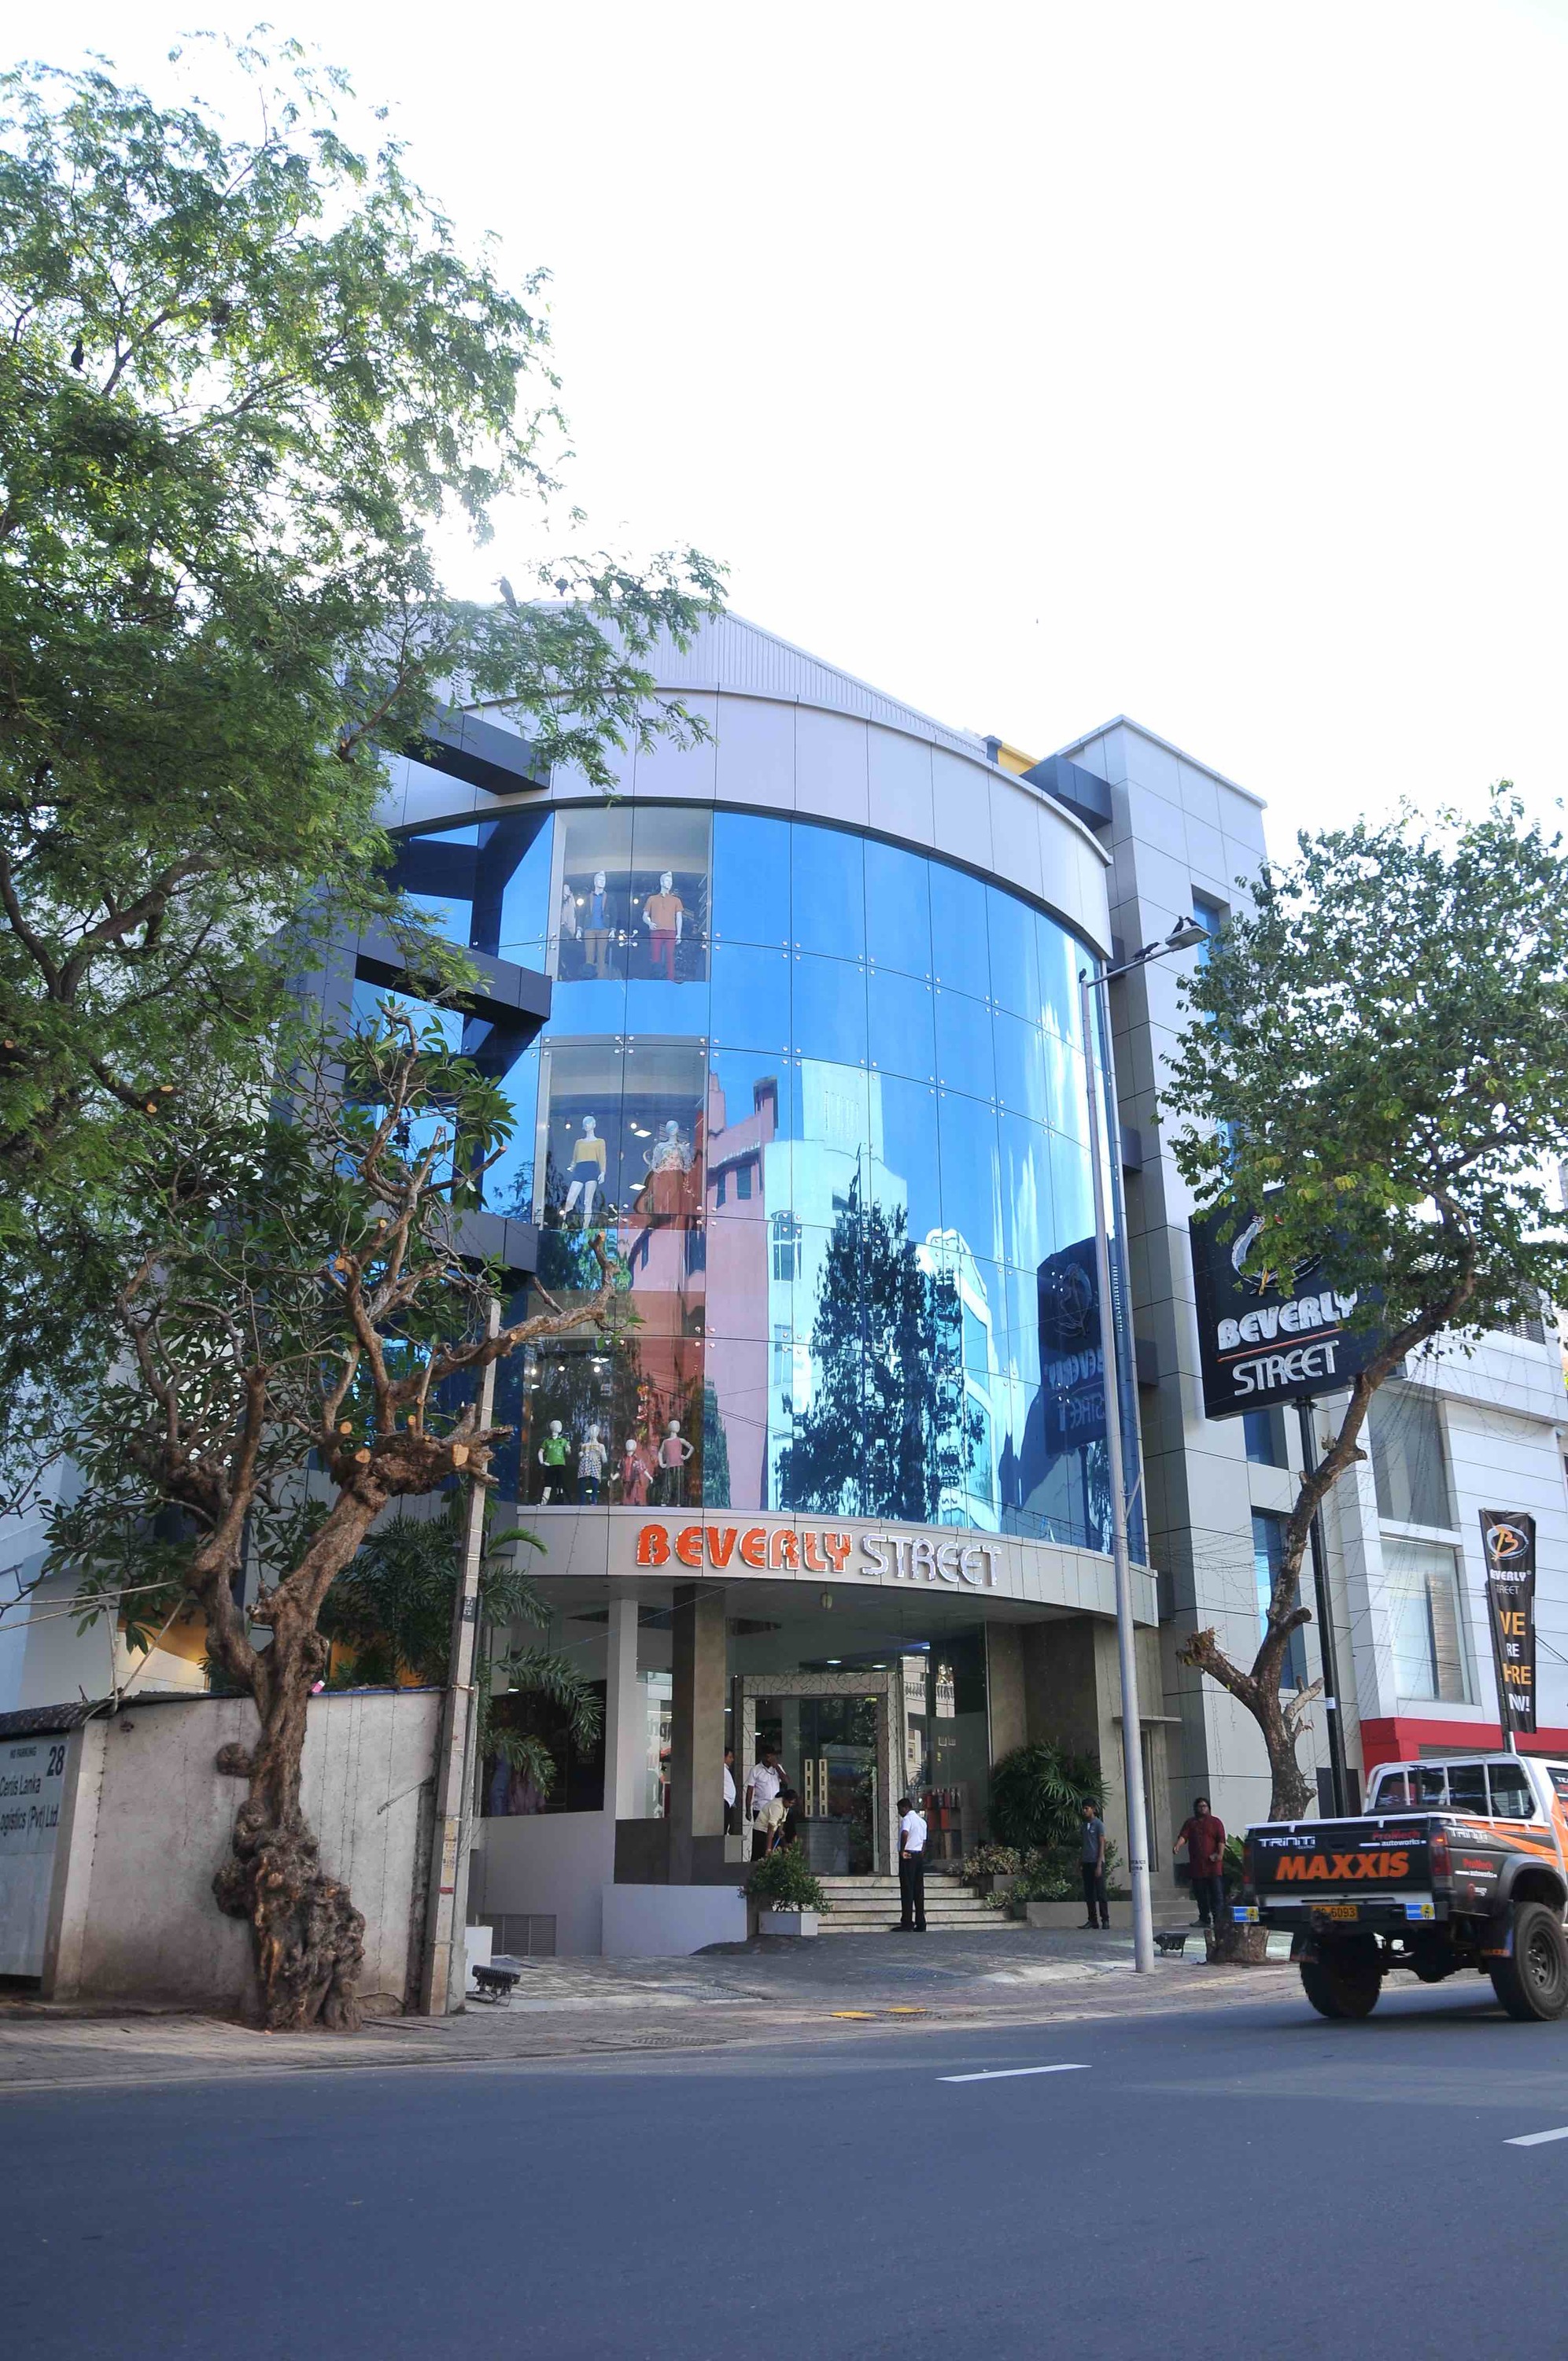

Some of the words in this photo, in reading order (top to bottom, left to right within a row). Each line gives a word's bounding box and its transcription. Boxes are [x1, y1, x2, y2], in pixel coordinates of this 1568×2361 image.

[1217, 1288, 1359, 1350] BEVERLY
[1232, 1339, 1340, 1396] STREET
[636, 1524, 853, 1573] BEVERLY
[861, 1533, 1003, 1587] STREET
[46, 1745, 65, 1777] 28
[19, 1772, 41, 1795] Lanka
[0, 1807, 26, 1837] ogistics
[1381, 1838, 1420, 1847] autoworks
[1275, 1851, 1410, 1881] MAXXIS
